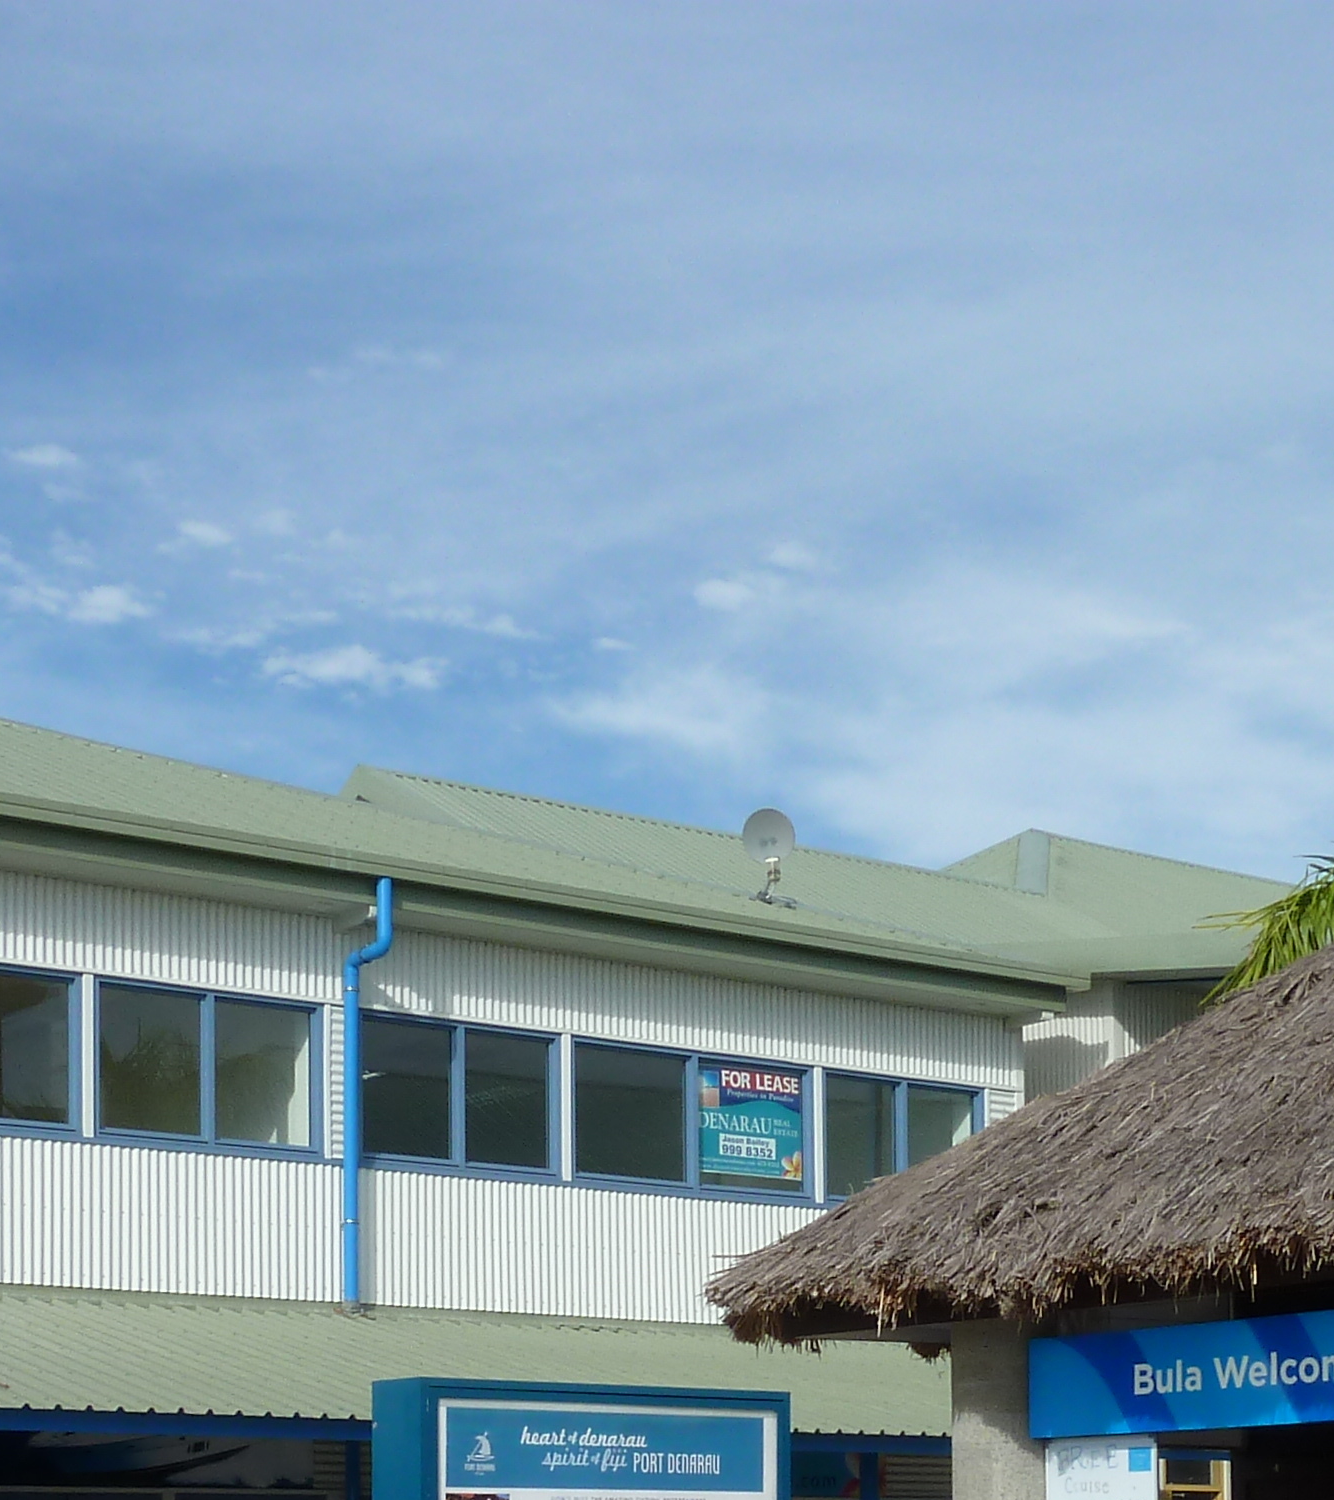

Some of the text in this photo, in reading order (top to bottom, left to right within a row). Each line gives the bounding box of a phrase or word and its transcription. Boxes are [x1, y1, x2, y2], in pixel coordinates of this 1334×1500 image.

[721, 1069, 799, 1094] FOR LEASE
[722, 1135, 770, 1147] Jason Bailey
[722, 1144, 773, 1158] 999 8352
[1133, 1359, 1203, 1395] Bula
[520, 1425, 567, 1446] heart
[578, 1427, 648, 1448] denarau
[541, 1446, 589, 1471] spirit
[633, 1452, 664, 1474] PORT
[667, 1453, 721, 1475] DENARAU
